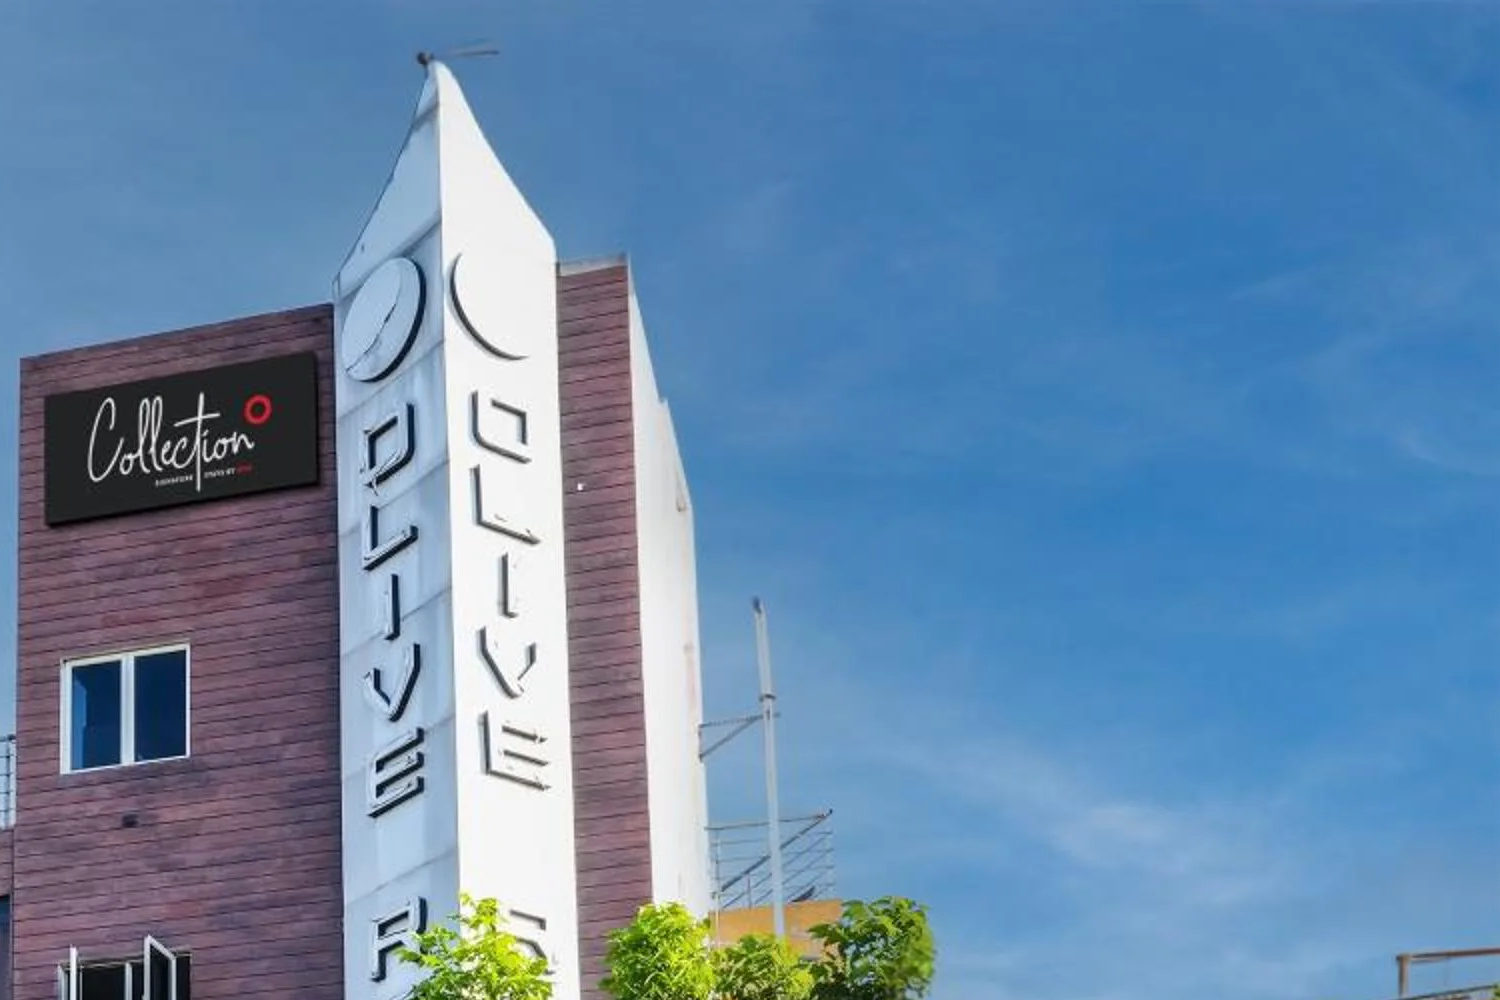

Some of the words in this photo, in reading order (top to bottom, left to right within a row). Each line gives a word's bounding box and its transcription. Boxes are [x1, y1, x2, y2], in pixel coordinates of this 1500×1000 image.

[88, 391, 255, 492] Collection
[360, 402, 426, 818] OLIVE
[470, 389, 551, 790] OLIVE
